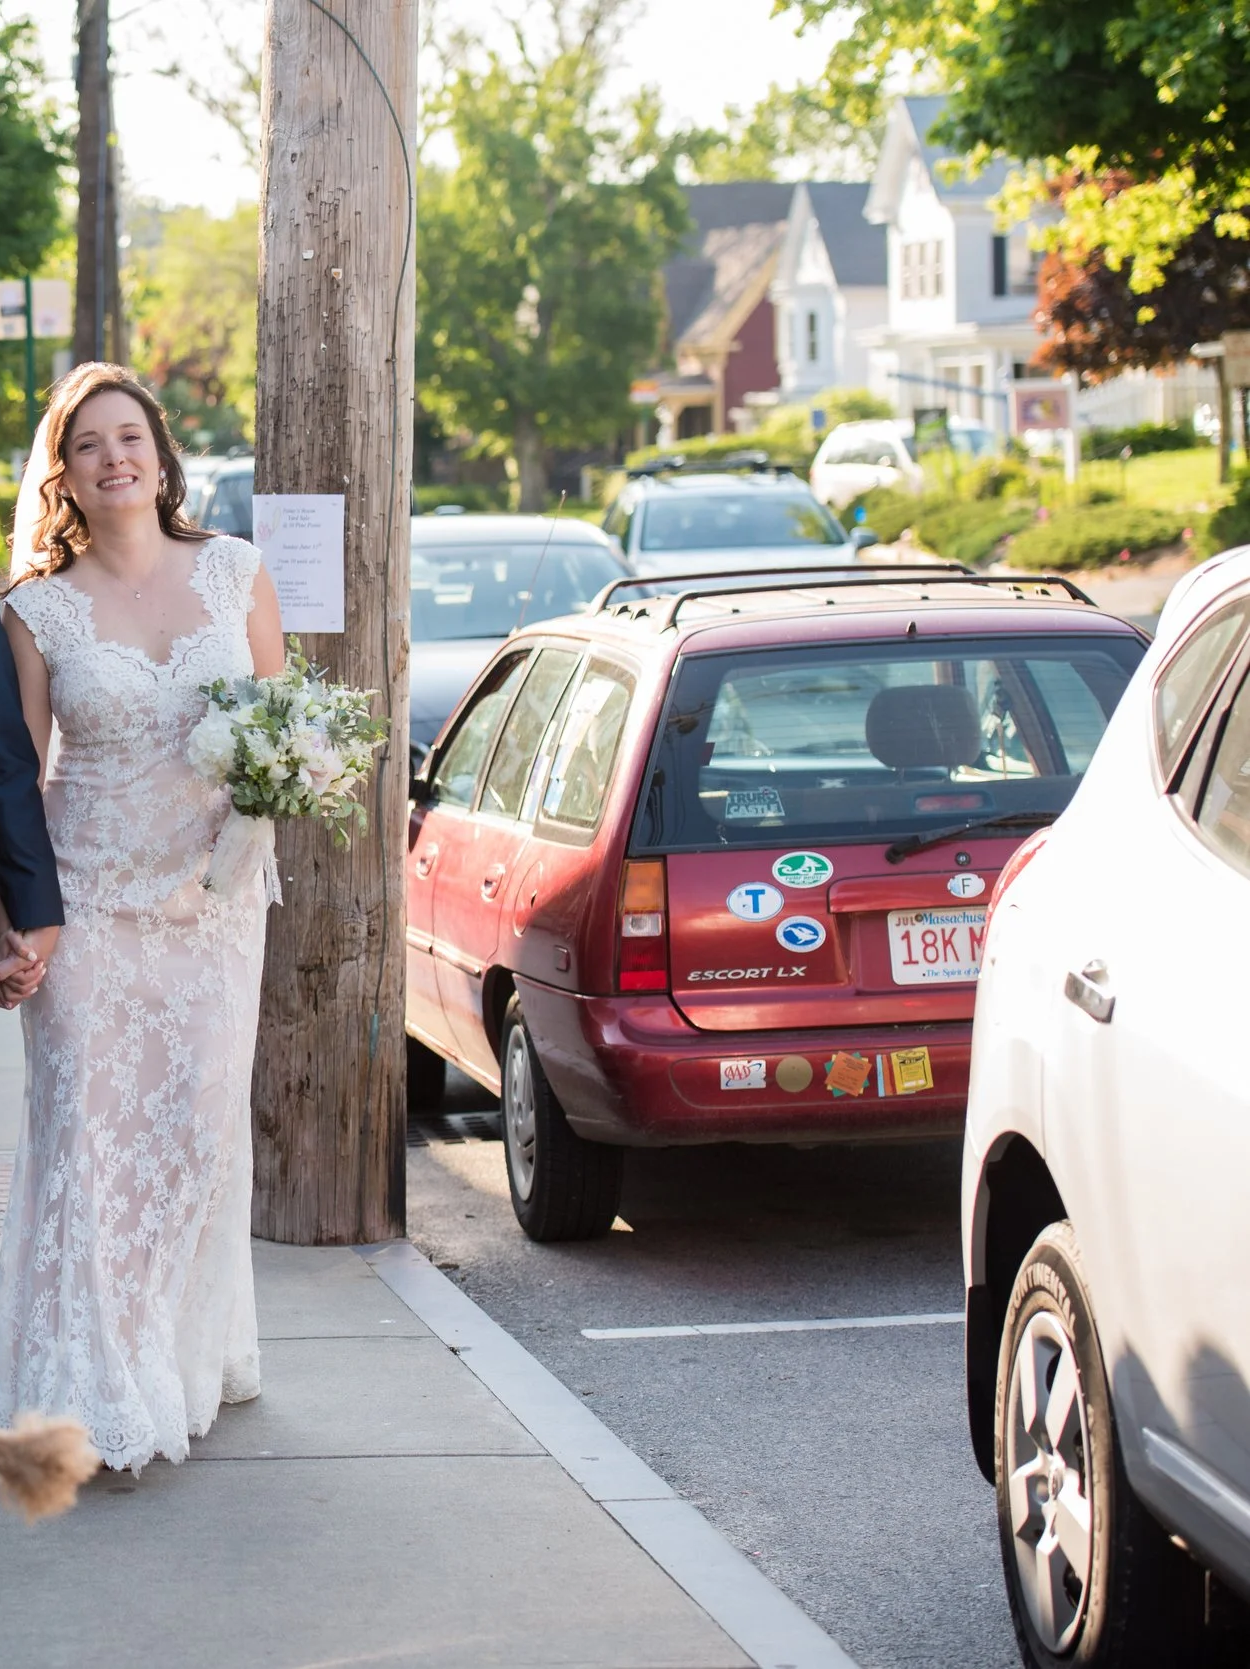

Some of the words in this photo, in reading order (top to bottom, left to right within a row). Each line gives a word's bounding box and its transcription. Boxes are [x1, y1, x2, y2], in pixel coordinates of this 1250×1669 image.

[729, 803, 779, 817] CASTLE
[961, 878, 972, 895] F
[745, 889, 766, 914] T
[895, 916, 916, 927] JUL
[900, 927, 960, 966] 18K
[687, 967, 773, 981] ESCORT
[776, 965, 807, 978] LX
